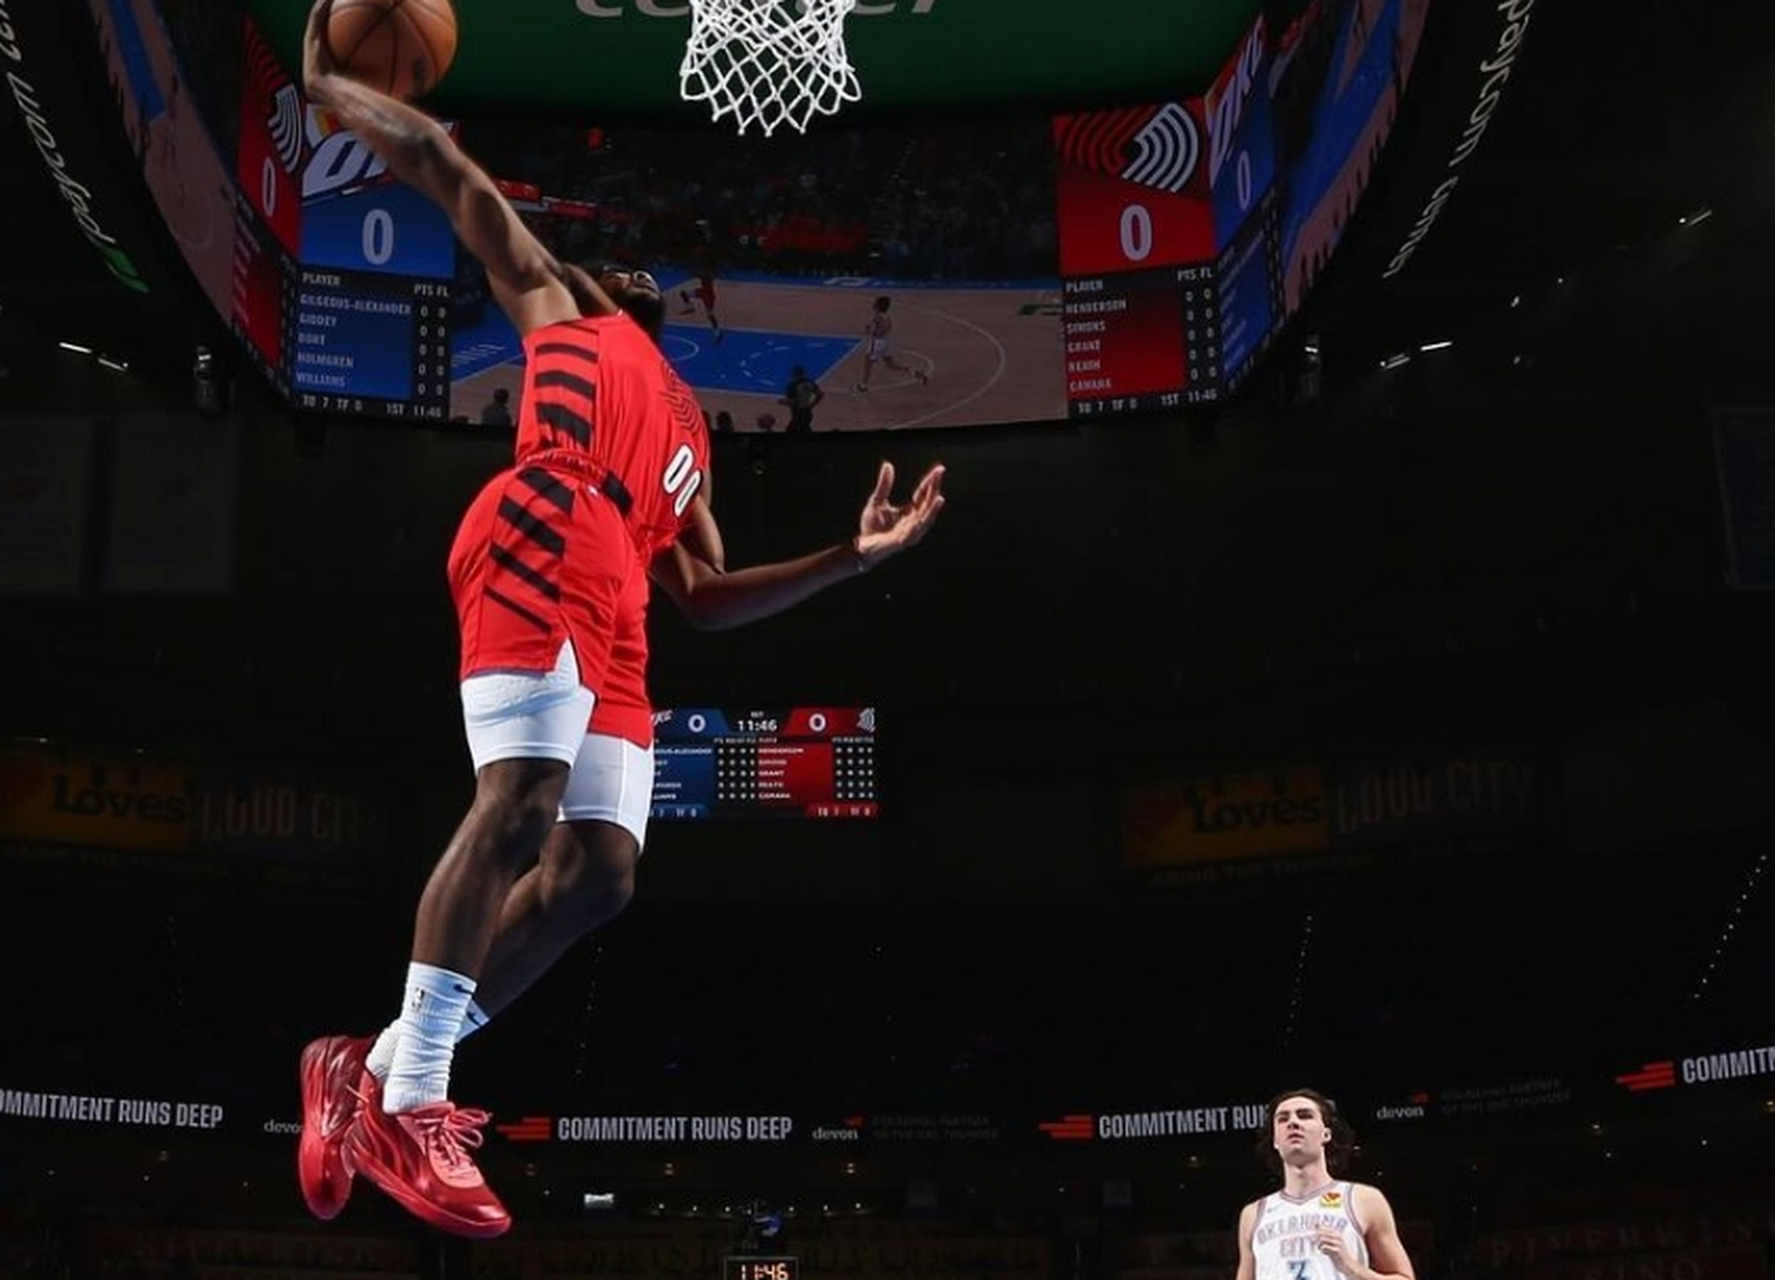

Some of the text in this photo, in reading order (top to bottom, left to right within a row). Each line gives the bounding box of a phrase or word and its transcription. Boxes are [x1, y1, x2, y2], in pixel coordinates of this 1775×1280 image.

[7, 72, 116, 243] paycom
[262, 156, 275, 217] 0
[1238, 150, 1250, 211] 0
[362, 208, 394, 265] 0
[1120, 204, 1152, 262] 0
[302, 272, 449, 297] PLAYER PTS FL
[1177, 269, 1197, 281] PTS
[1201, 266, 1213, 278] FL
[662, 443, 702, 518] 00
[688, 714, 706, 733] 0
[738, 719, 778, 731] 11:46
[809, 713, 827, 732] 0
[118, 1099, 171, 1125] RUNS
[176, 1103, 223, 1128] DEEP
[1099, 1104, 1269, 1139] COMMITMENT RUN
[1377, 1105, 1424, 1120] devon
[558, 1116, 793, 1141] COMMITMENT RUNS DEEP
[812, 1126, 858, 1140] devon
